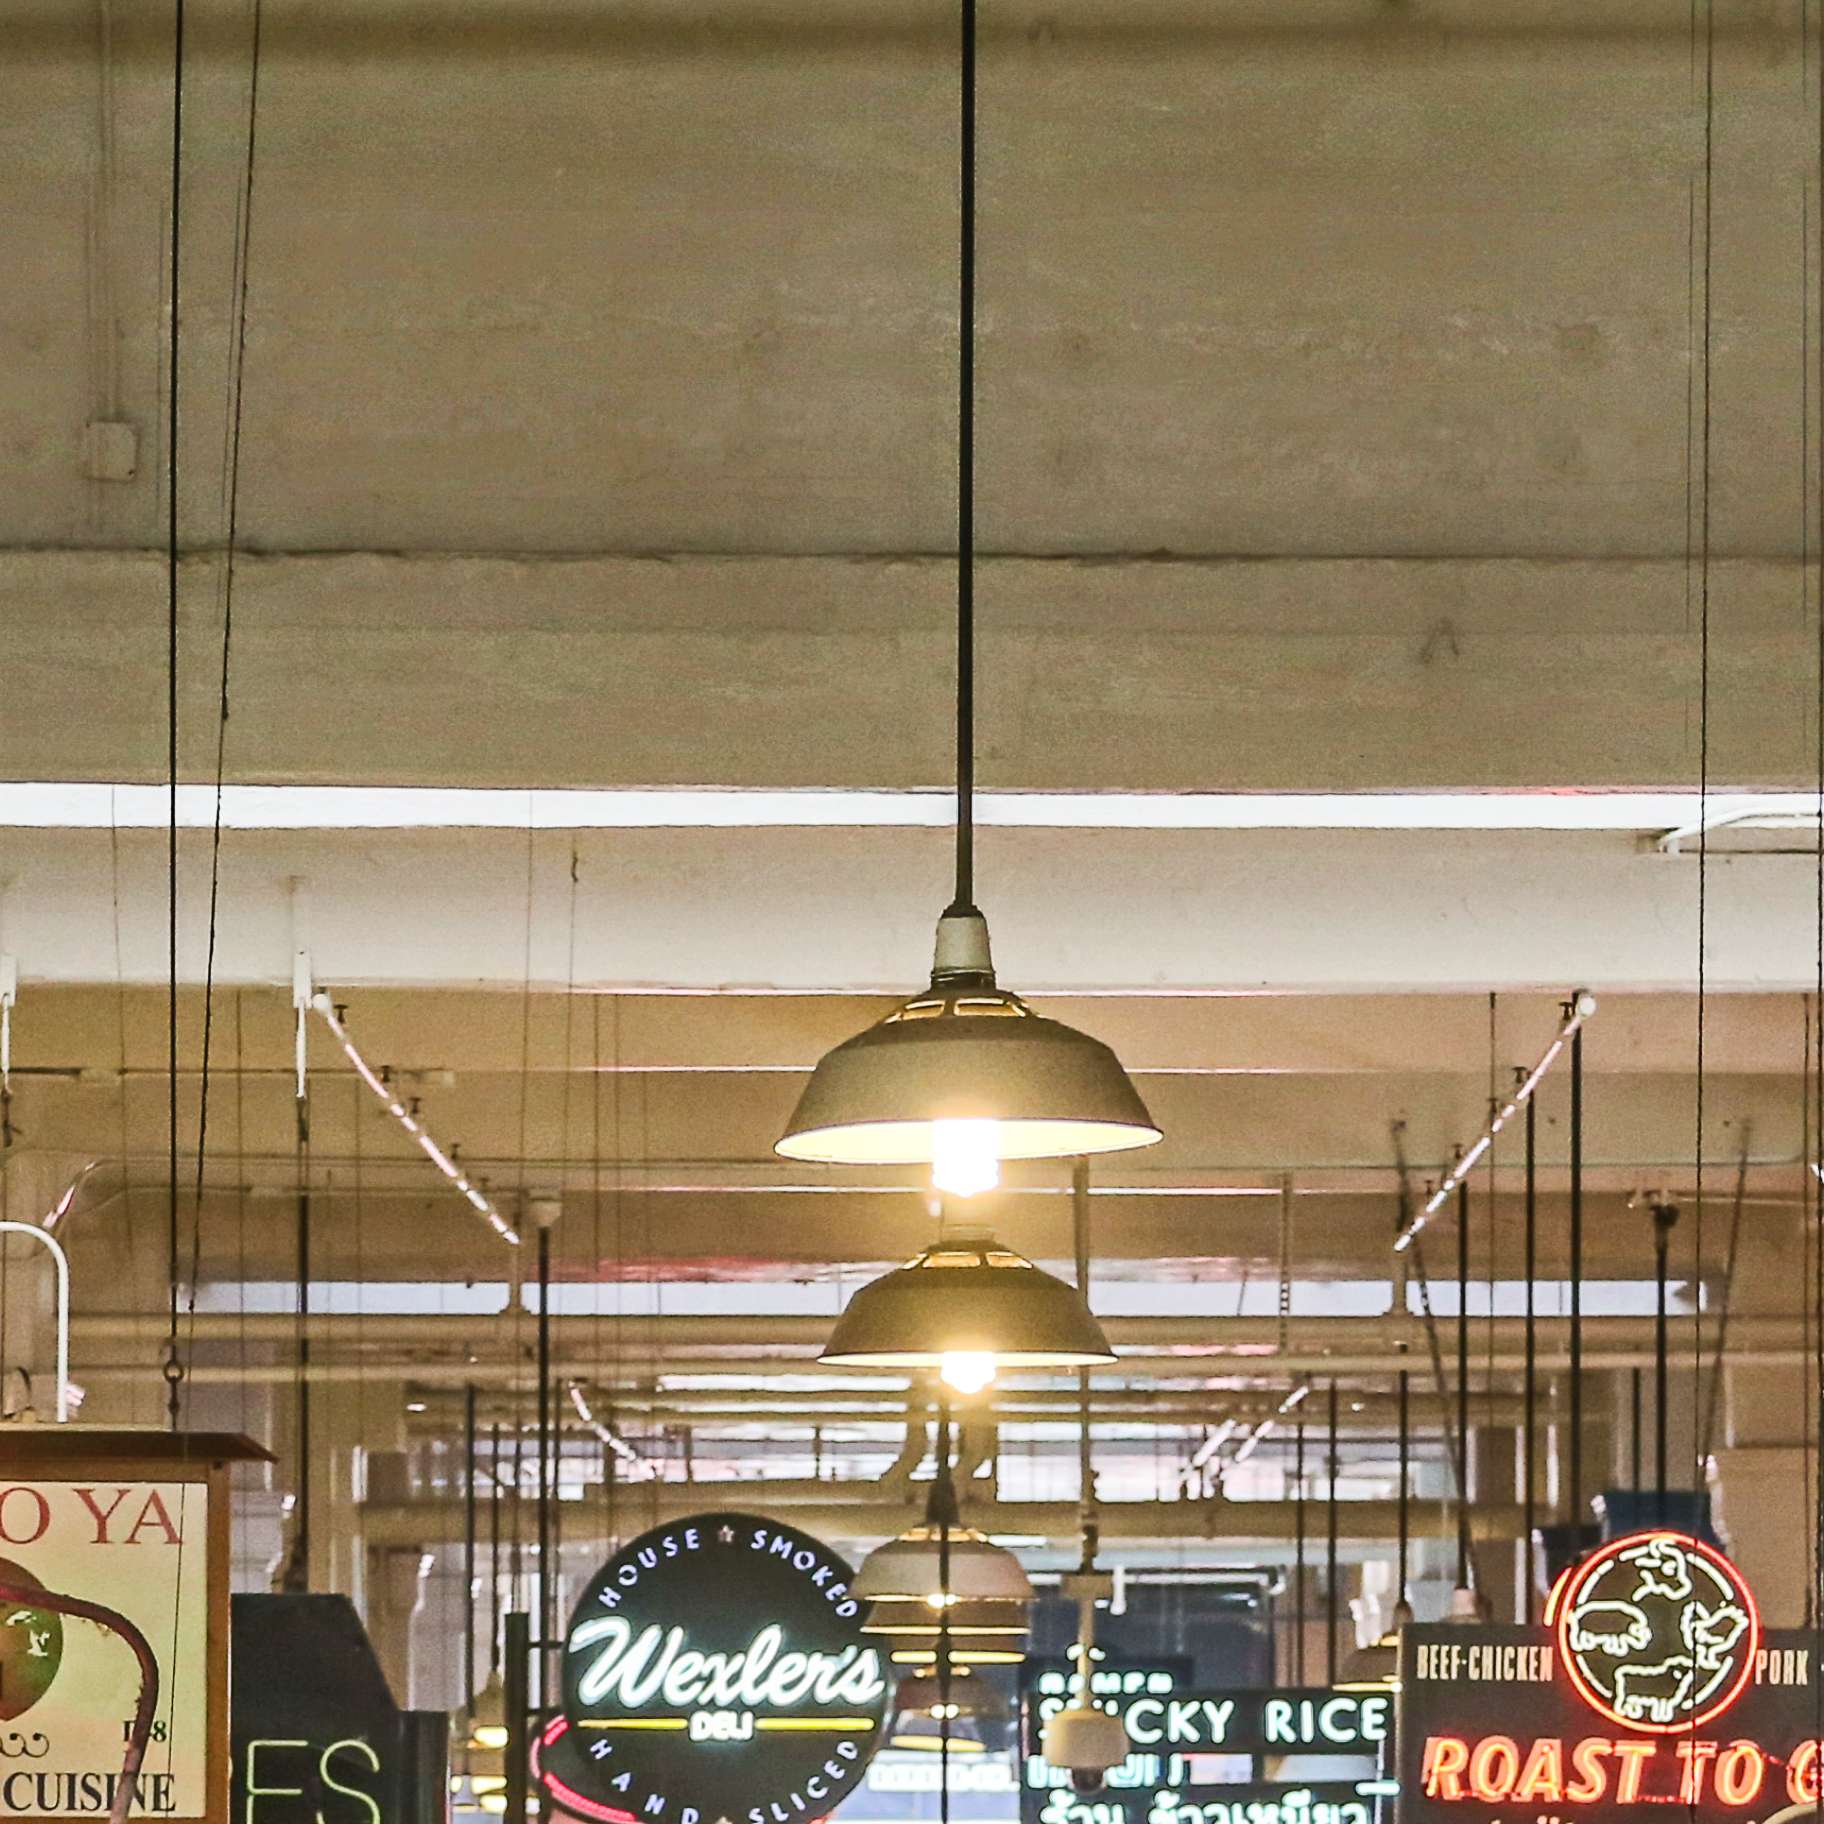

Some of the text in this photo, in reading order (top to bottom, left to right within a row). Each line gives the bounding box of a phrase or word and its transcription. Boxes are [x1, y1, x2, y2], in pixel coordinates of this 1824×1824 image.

[74, 1487, 184, 1545] YA
[598, 1528, 858, 1619] HOUSE SMOKED
[569, 1616, 887, 1708] Wexler's
[1754, 1649, 1809, 1687] PORK
[689, 1711, 755, 1742] DELI
[1265, 1697, 1389, 1744] RICE
[1421, 1733, 1658, 1806] ROAST
[1676, 1738, 1765, 1806] TO
